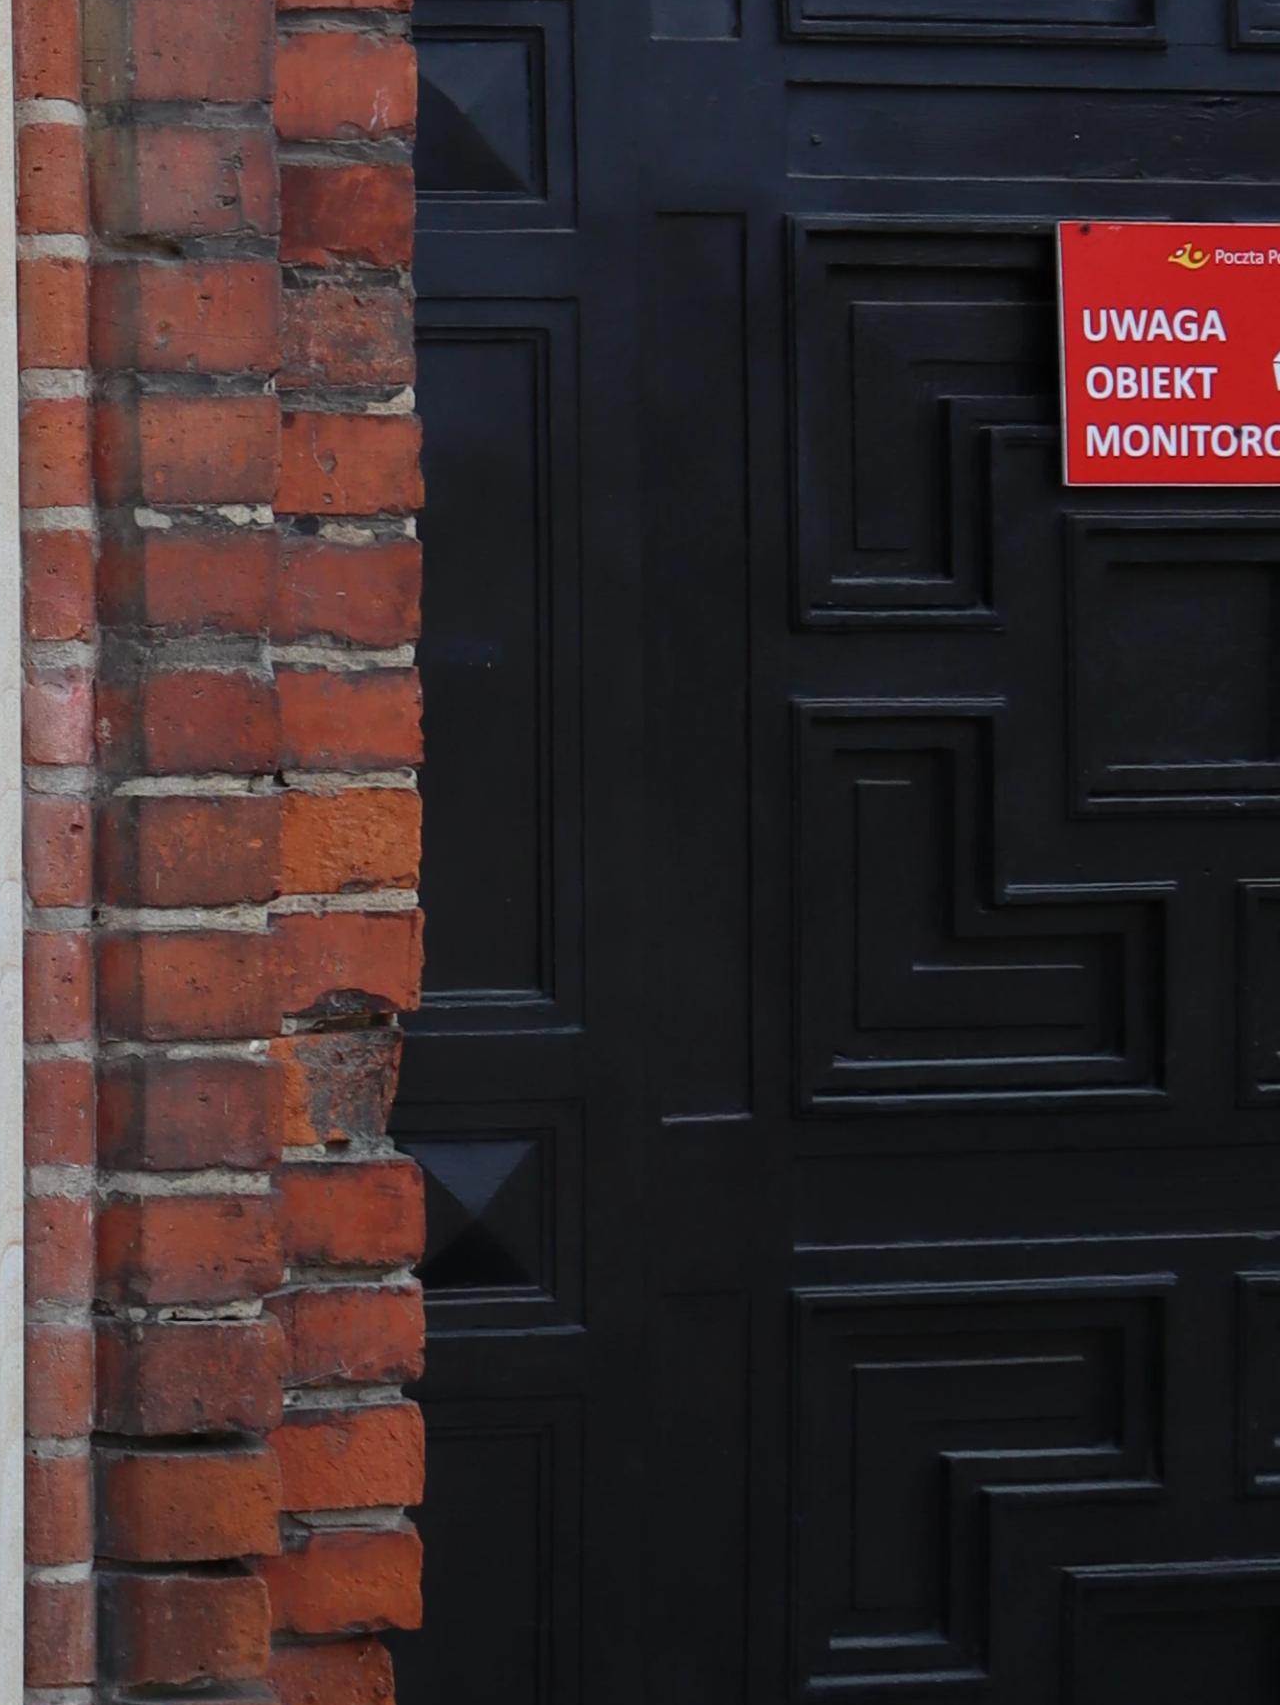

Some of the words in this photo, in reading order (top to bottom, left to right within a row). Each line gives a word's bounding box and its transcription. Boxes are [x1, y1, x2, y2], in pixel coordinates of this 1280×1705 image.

[1215, 248, 1265, 265] Poczta
[1081, 308, 1228, 343] UWAGA
[1084, 365, 1219, 400] OBIEKT
